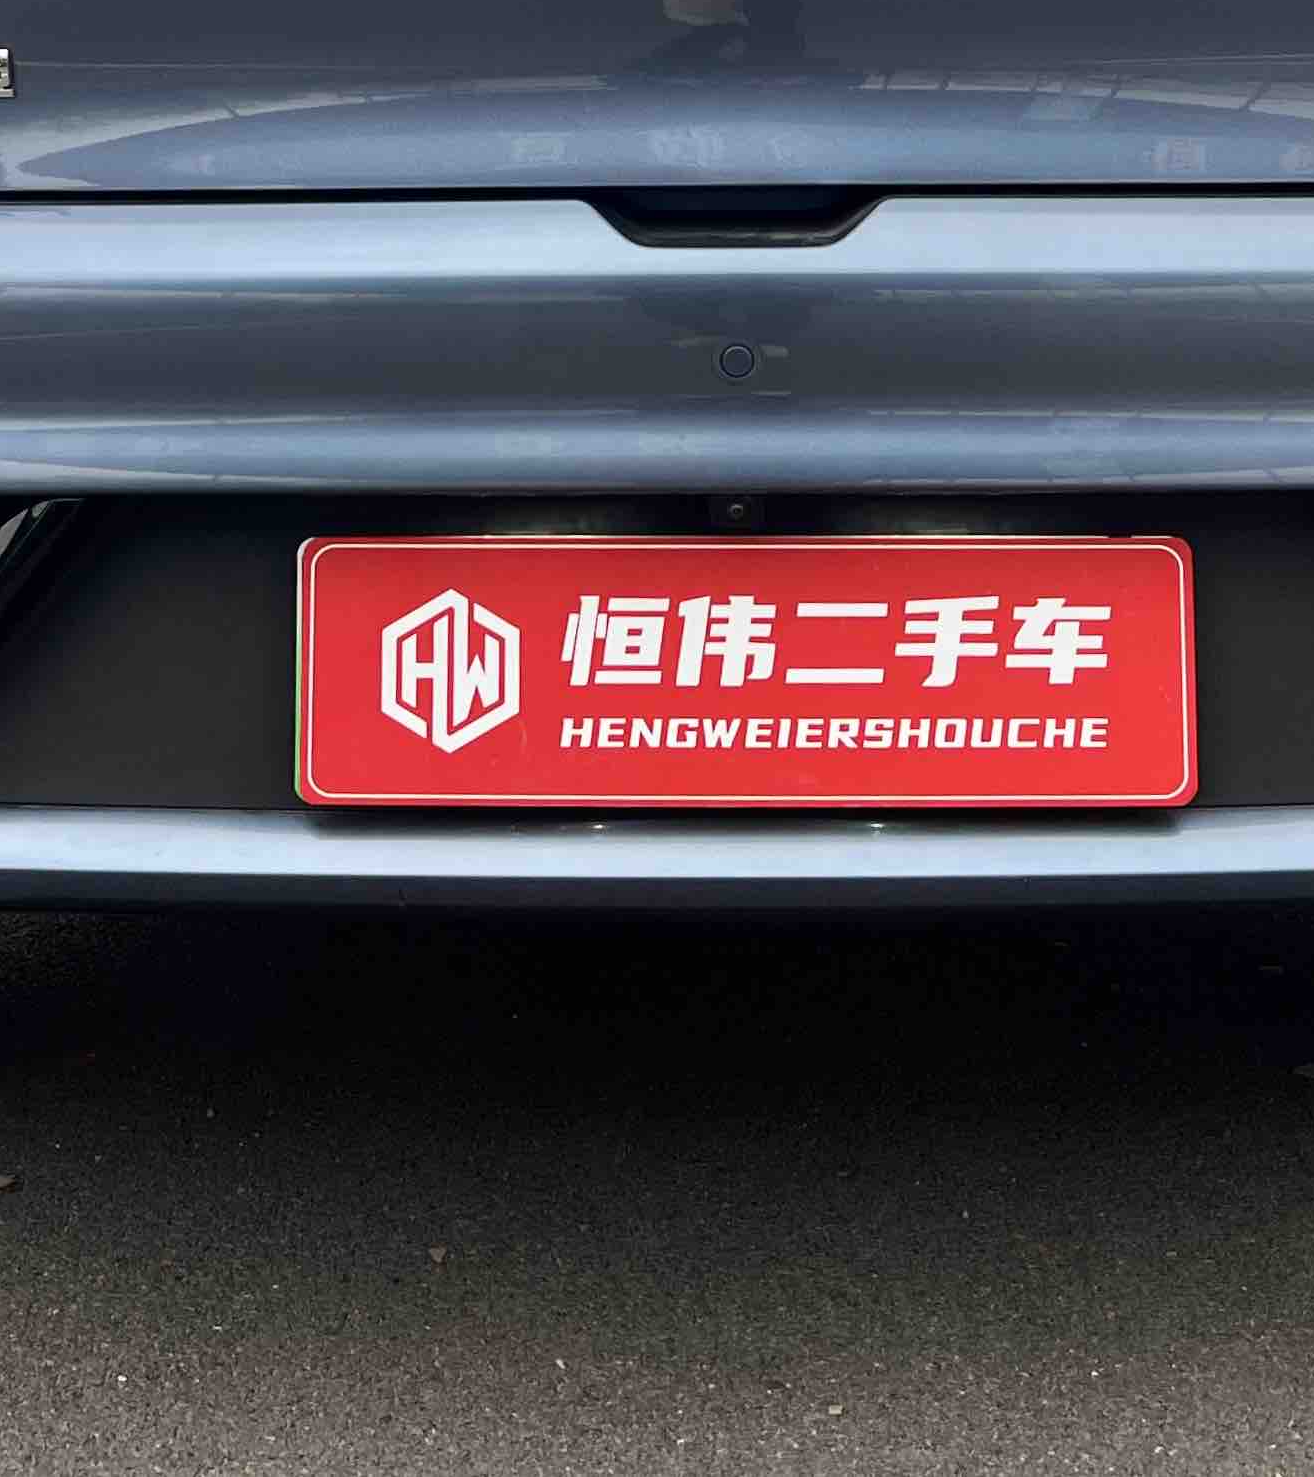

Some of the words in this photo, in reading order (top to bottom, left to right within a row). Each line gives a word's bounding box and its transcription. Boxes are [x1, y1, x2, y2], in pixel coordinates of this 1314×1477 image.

[560, 594, 1112, 687] 恒伟二手车
[559, 717, 1109, 748] HENGWEIERSHOUCHE
